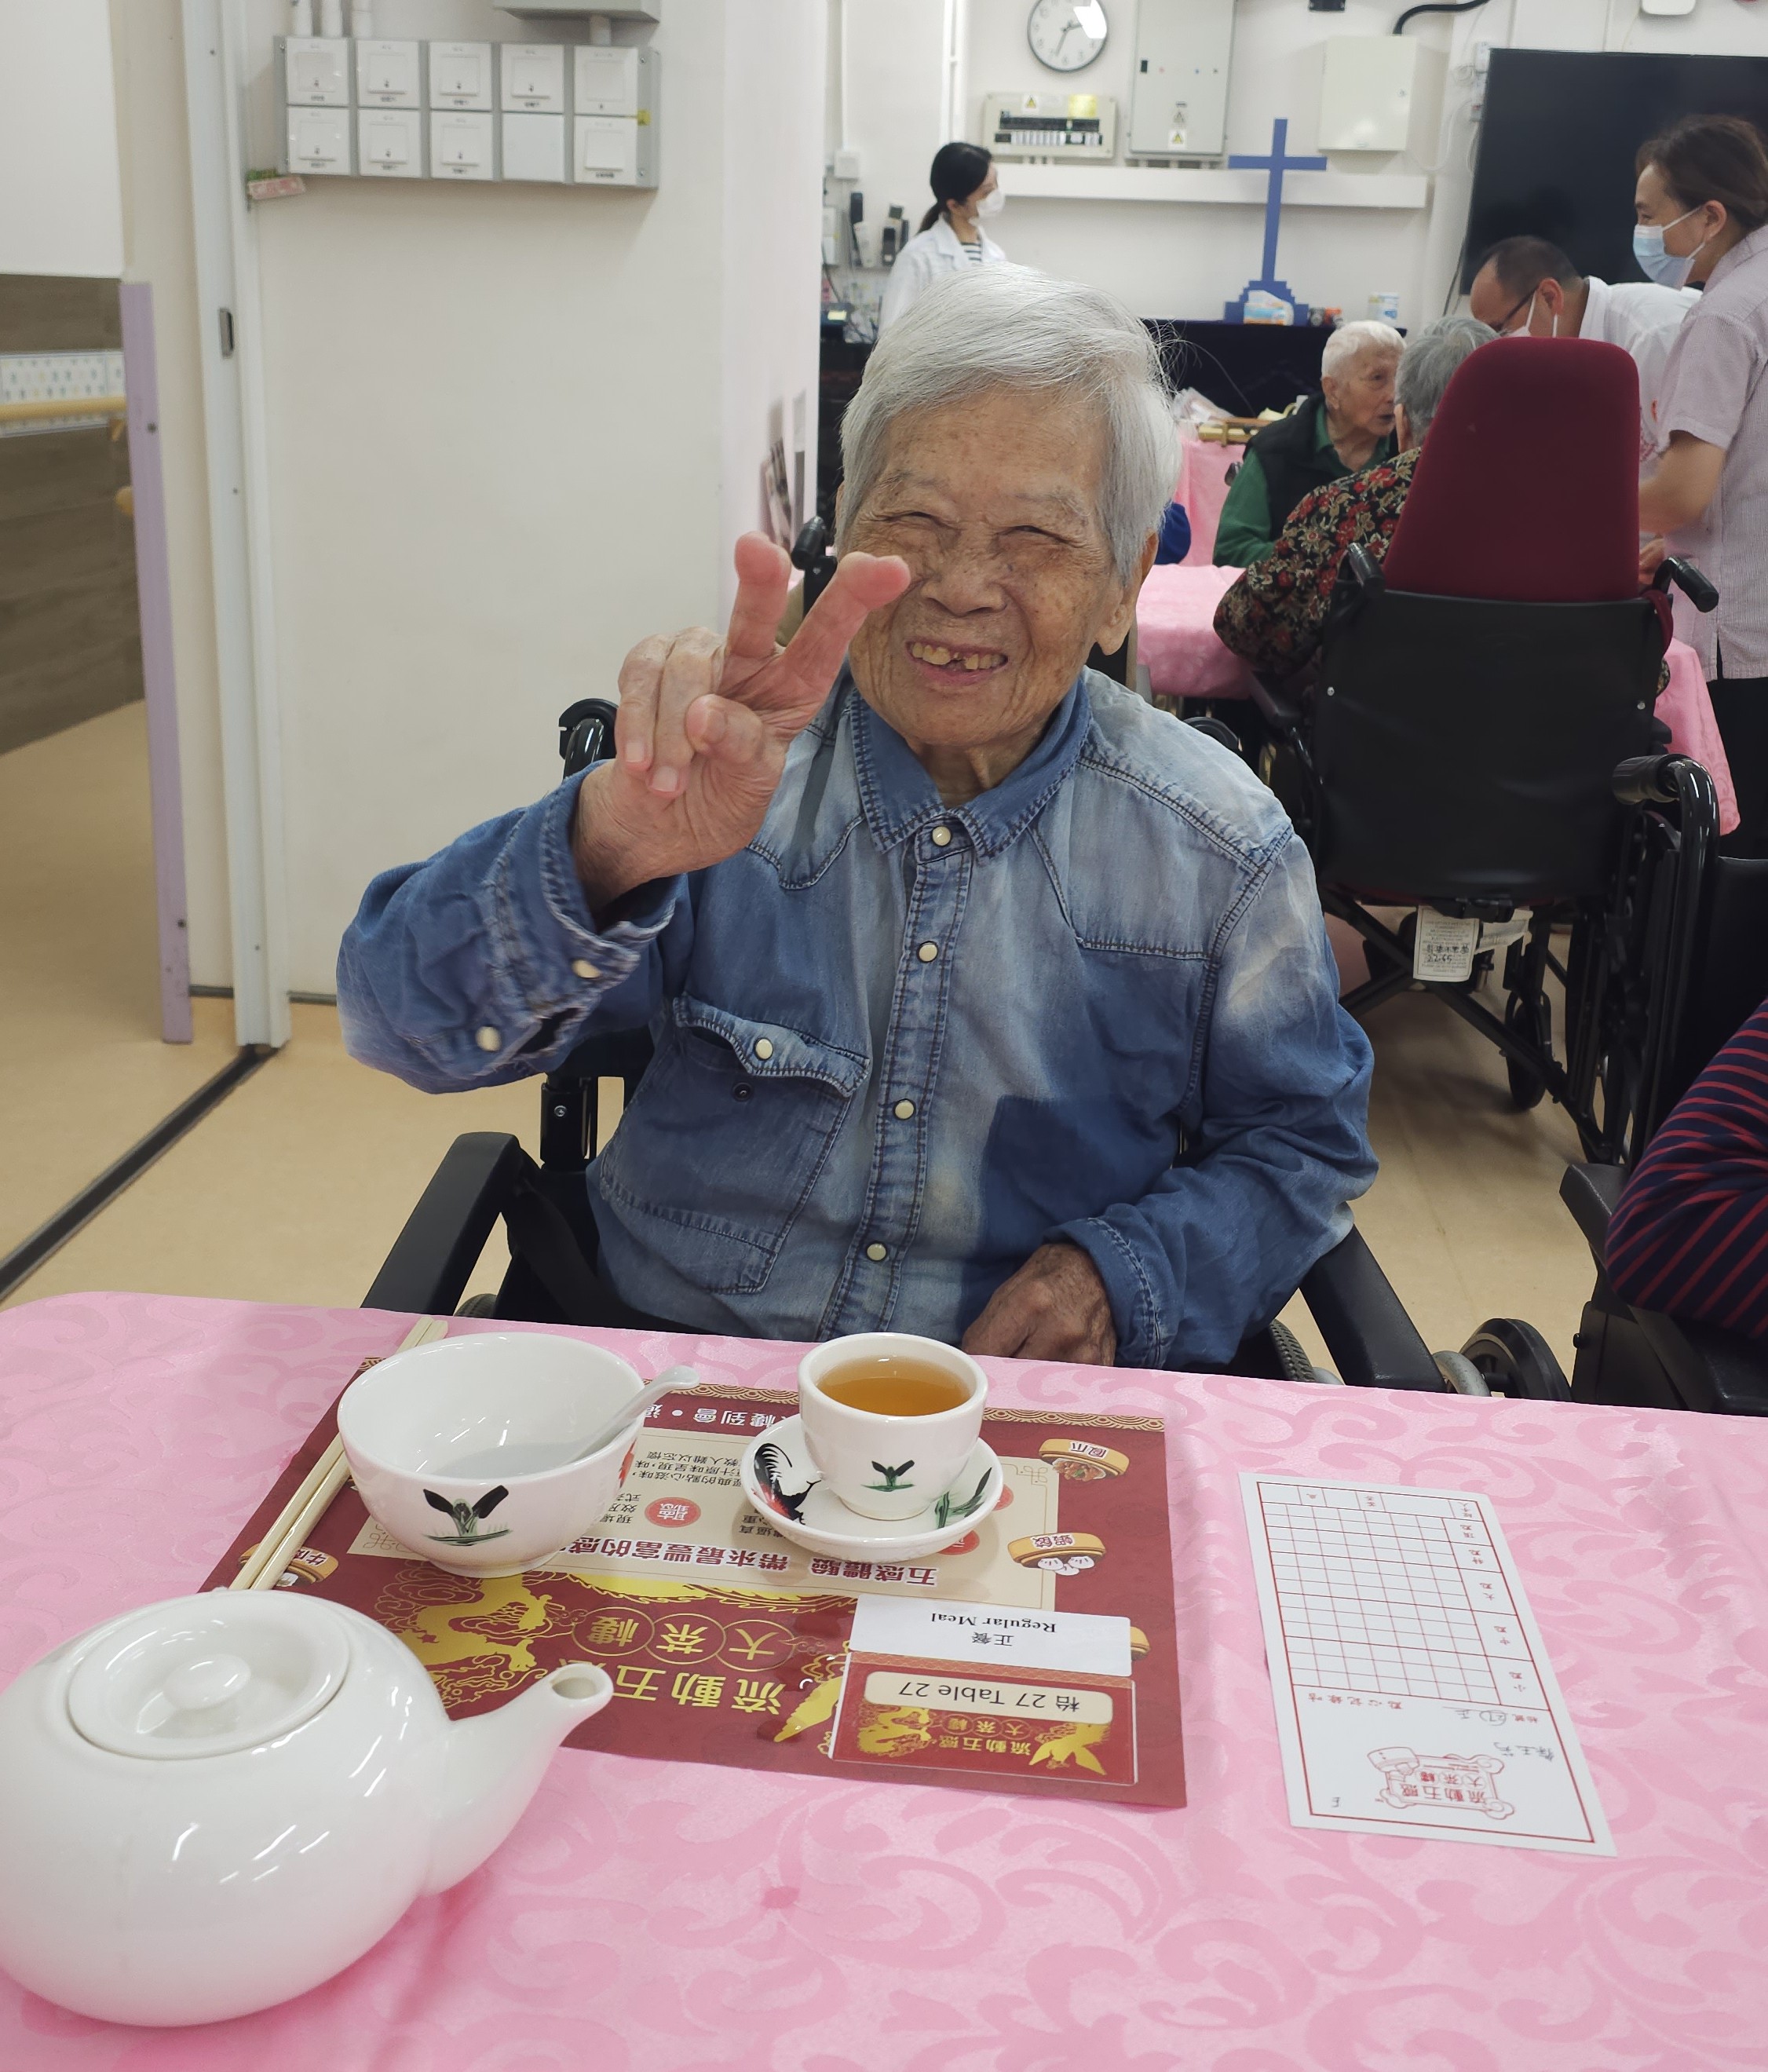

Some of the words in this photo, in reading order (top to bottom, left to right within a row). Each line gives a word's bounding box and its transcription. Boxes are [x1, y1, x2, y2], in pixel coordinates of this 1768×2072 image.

[692, 1407, 786, 1428] 樓到會
[645, 1451, 740, 1467] 教人難以忘懷
[656, 1502, 689, 1522] 聽
[1032, 1534, 1073, 1548] 蝦餃
[559, 1537, 789, 1572] 帶來最豐富的感
[809, 1557, 937, 1587] 五感體驗
[930, 1612, 977, 1625] Meal
[982, 1617, 1057, 1634] Regular
[586, 1616, 778, 1661] 大茶樓
[970, 1631, 1014, 1647] 正餐
[559, 1658, 786, 1715] 流動五
[898, 1681, 930, 1697] 27
[937, 1684, 1006, 1705] Table
[1015, 1692, 1047, 1709] 27
[947, 1717, 1025, 1736] 大茶樓
[937, 1734, 1032, 1756] 流動五感
[1419, 1771, 1483, 1788] 大茶樓
[1399, 1783, 1486, 1804] 流動五感
